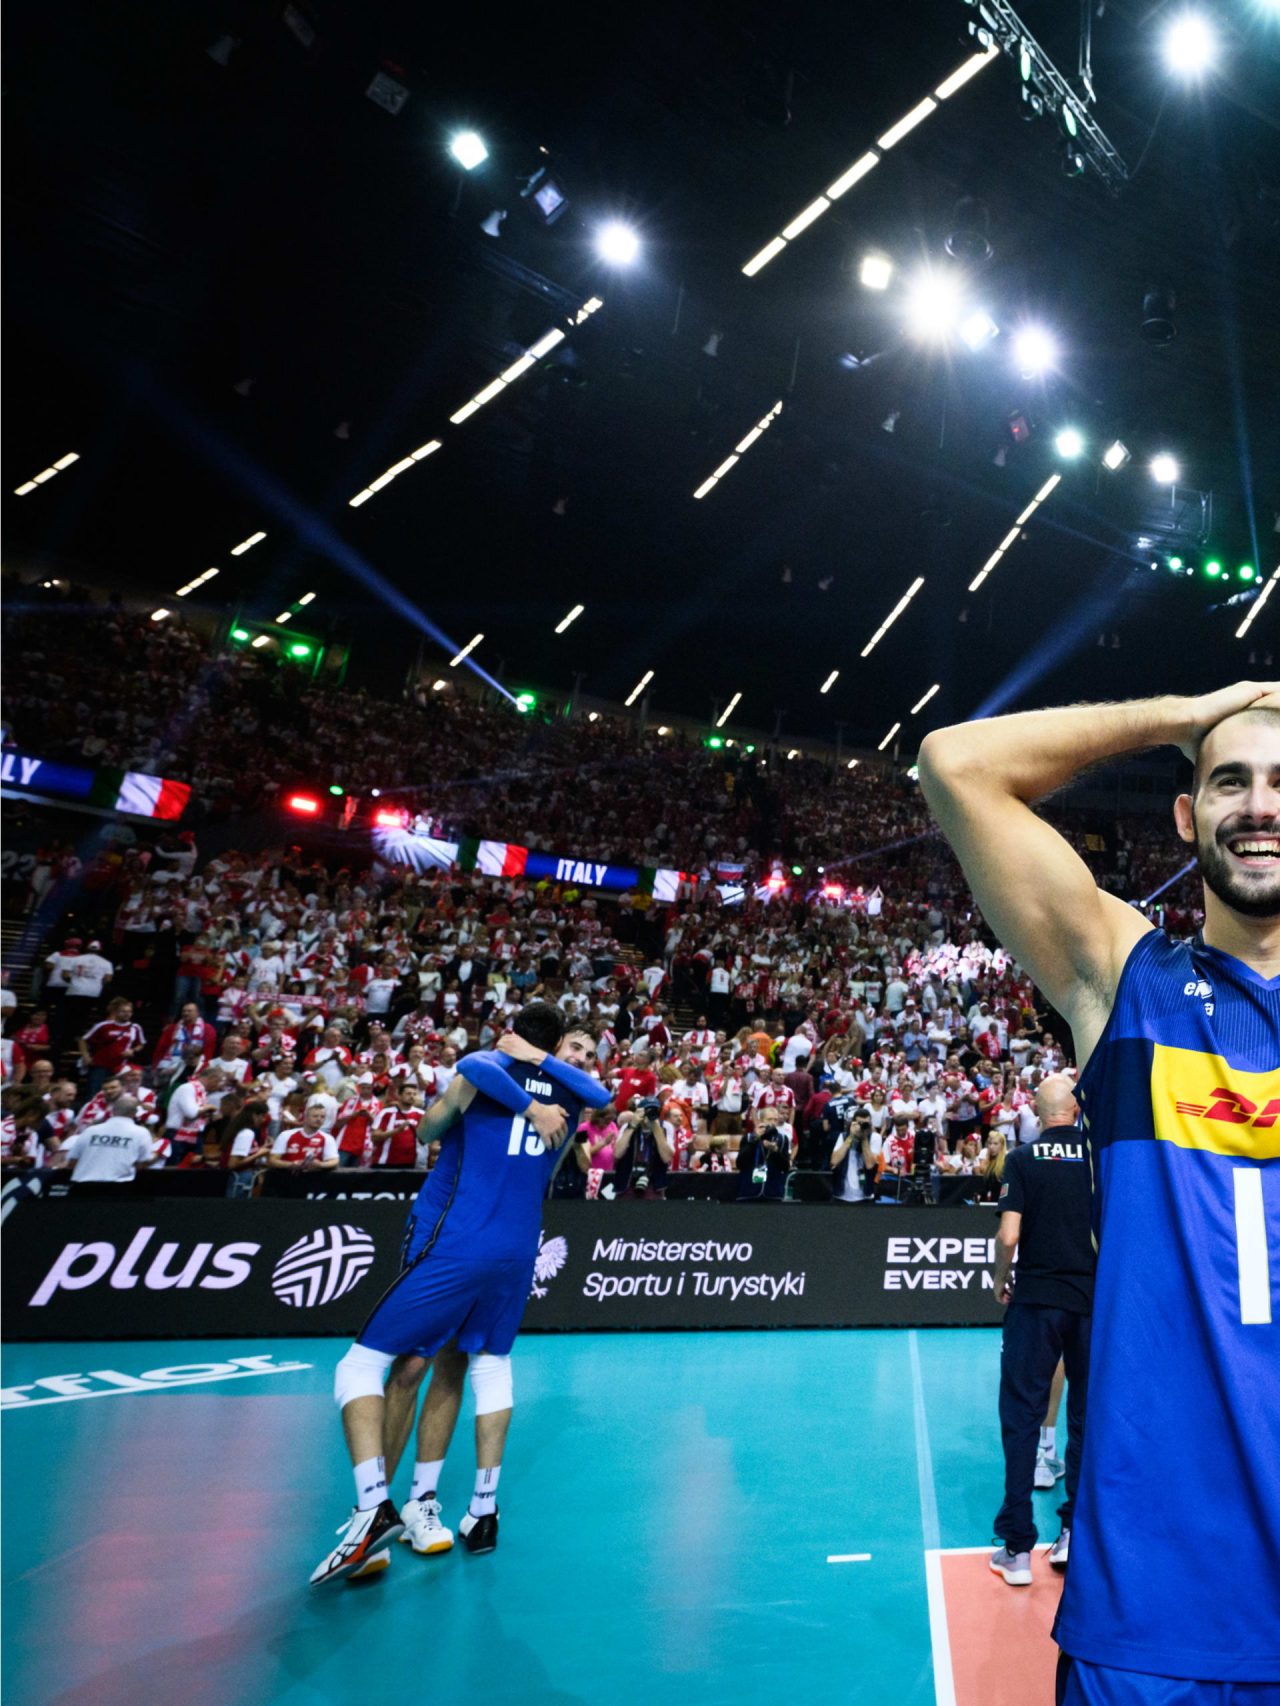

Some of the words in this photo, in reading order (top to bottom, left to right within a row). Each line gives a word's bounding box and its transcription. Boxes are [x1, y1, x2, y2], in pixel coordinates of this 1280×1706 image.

[556, 858, 607, 886] ITALY
[89, 1134, 133, 1149] FORT
[592, 1238, 753, 1262] Ministerstwo
[28, 1226, 262, 1306] plus
[582, 1272, 673, 1302] Sportu
[676, 1272, 687, 1296] i
[691, 1271, 806, 1301] Turystyki
[883, 1270, 975, 1290] EVERY
